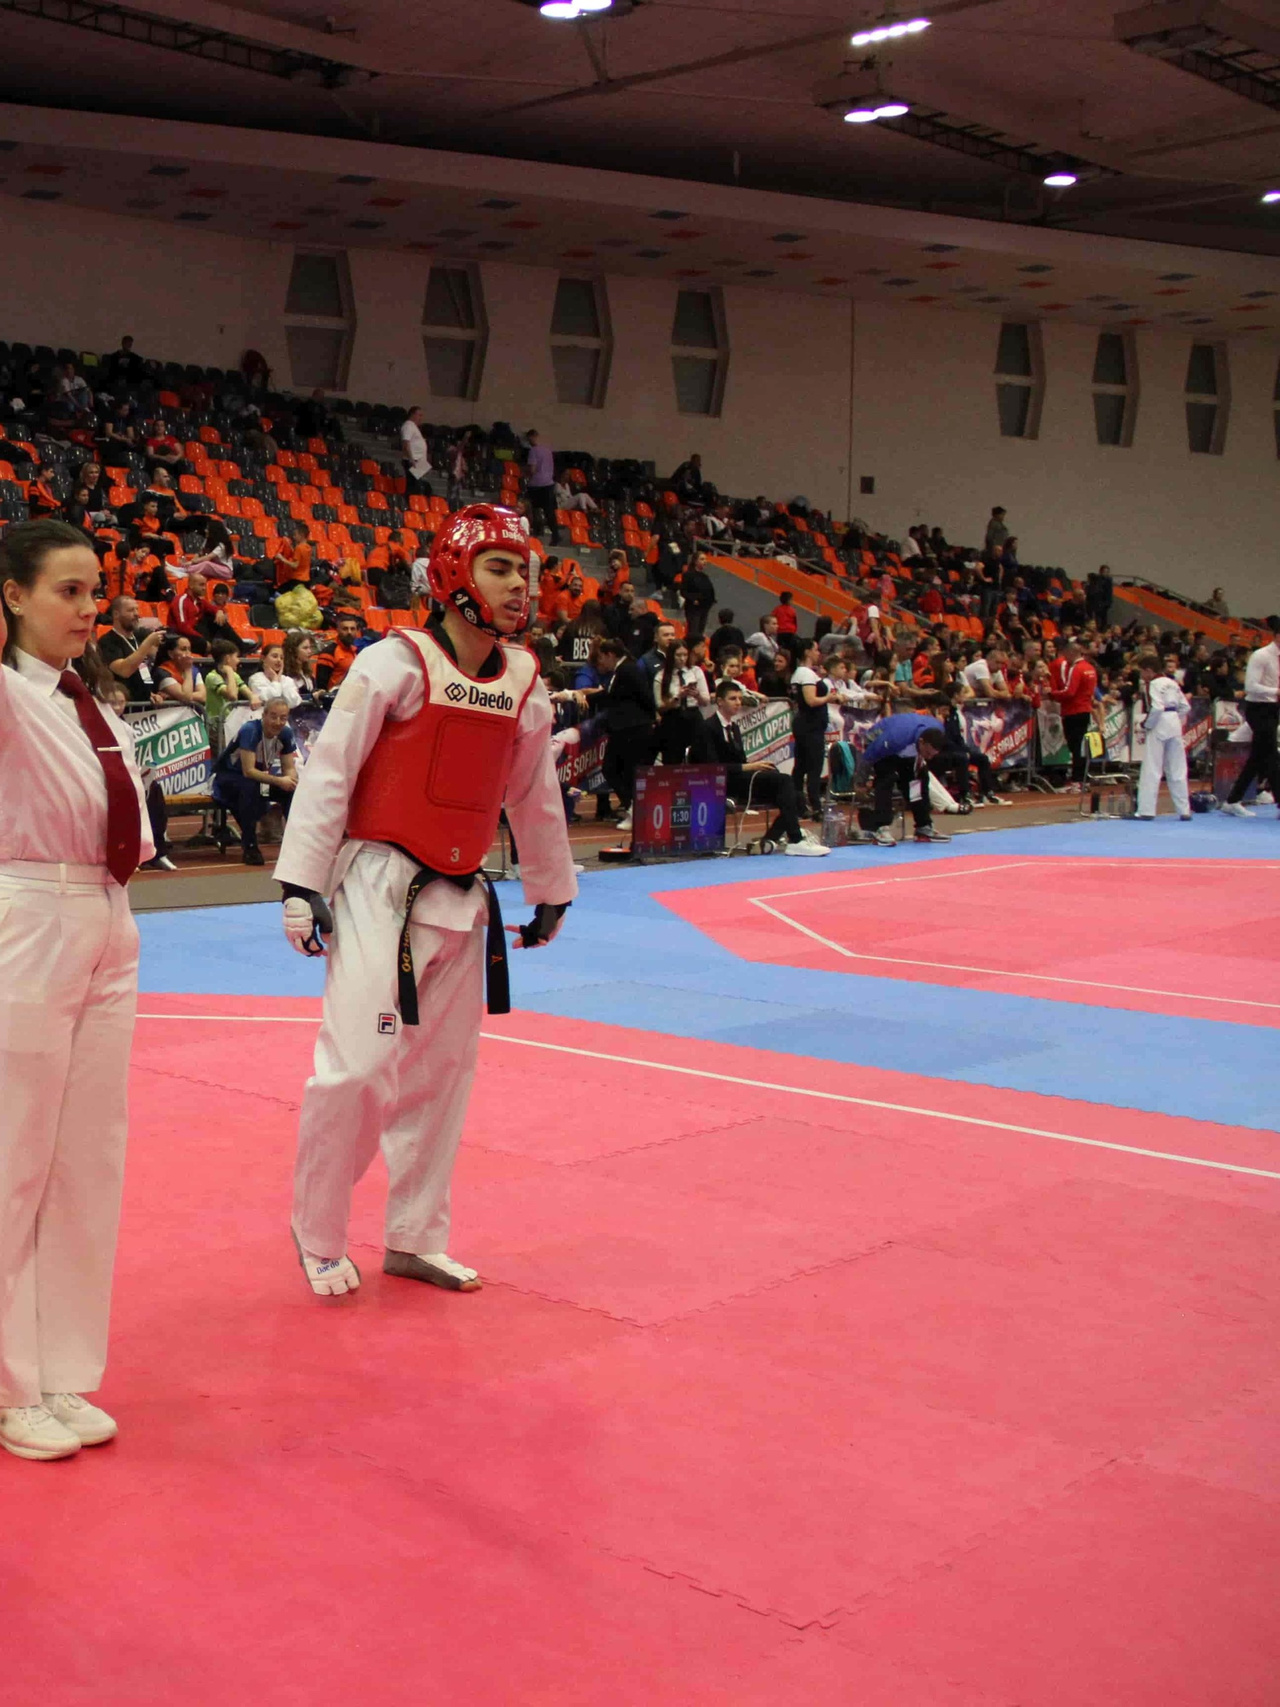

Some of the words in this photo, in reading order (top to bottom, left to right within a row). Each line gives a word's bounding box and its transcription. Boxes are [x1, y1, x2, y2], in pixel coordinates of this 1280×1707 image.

[573, 638, 590, 660] BES
[468, 685, 513, 711] Daedo
[765, 712, 791, 741] OPEN
[157, 721, 203, 759] OPEN
[160, 763, 206, 796] WONDO
[653, 804, 664, 830] 0
[672, 811, 690, 823] 1:30
[698, 802, 708, 827] 0
[450, 847, 460, 863] 3
